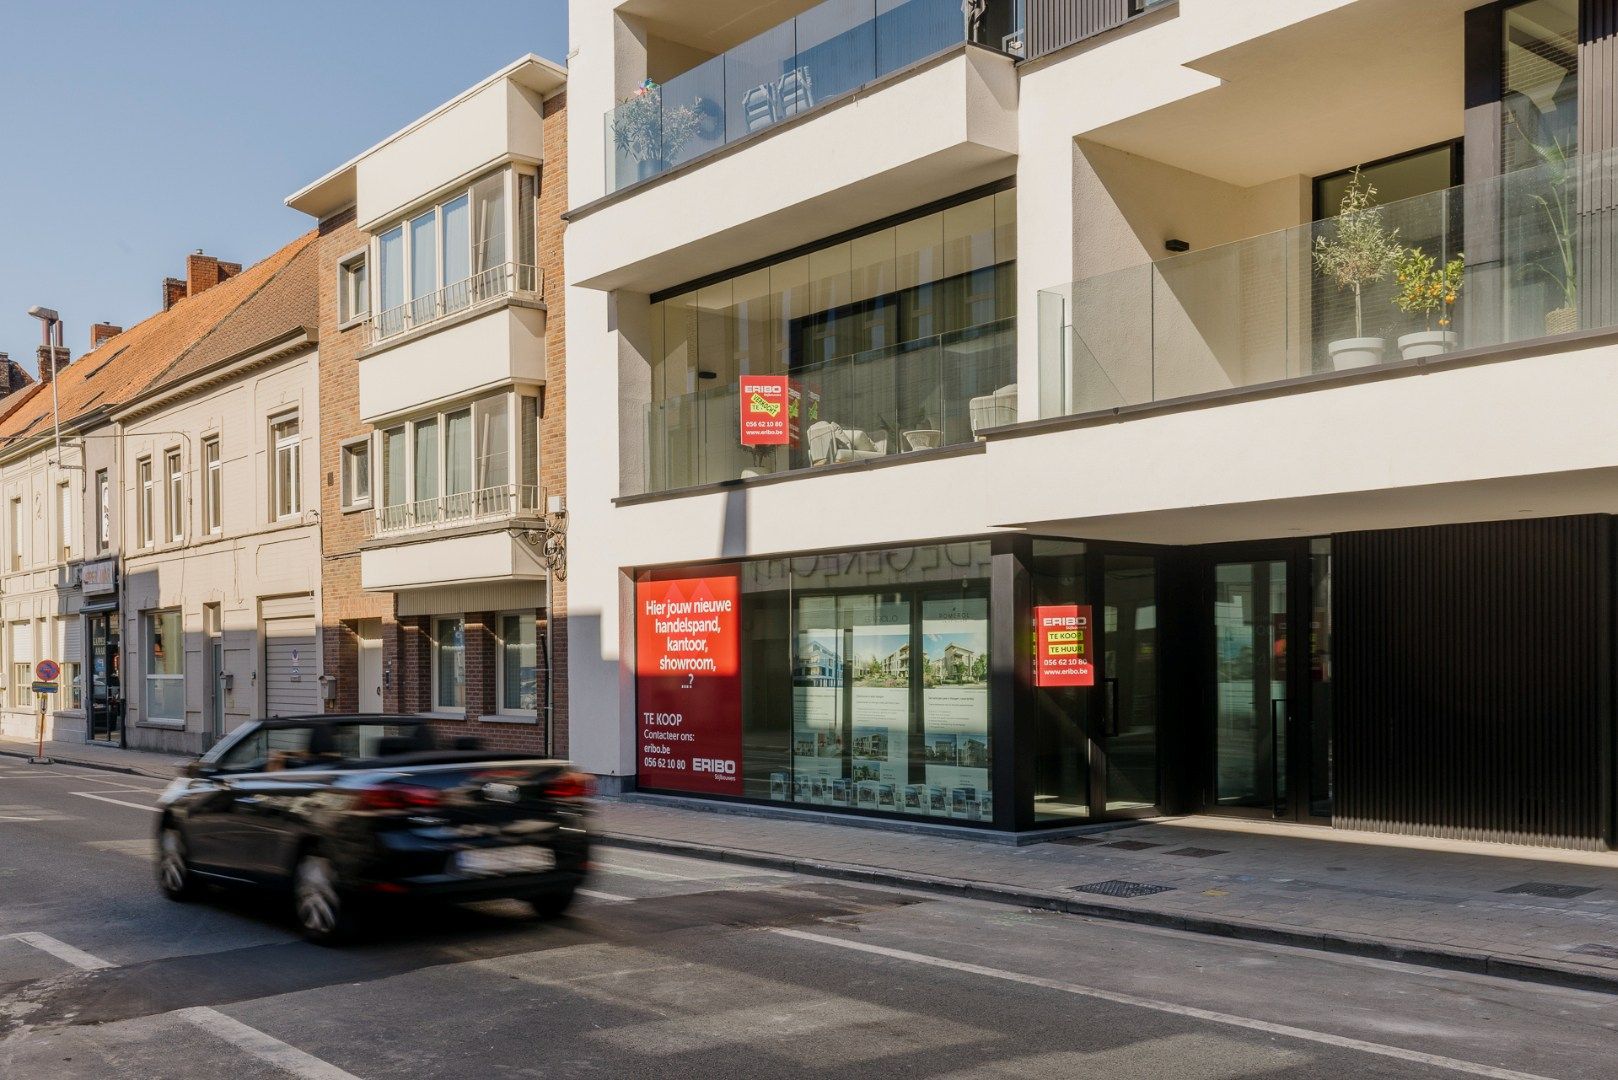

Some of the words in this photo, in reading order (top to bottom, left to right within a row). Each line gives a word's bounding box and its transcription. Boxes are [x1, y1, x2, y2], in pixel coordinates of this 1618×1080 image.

[744, 385, 782, 393] ERIBO
[645, 600, 666, 615] Hier
[666, 599, 692, 618] jouw
[694, 598, 732, 613] nieuwe
[655, 616, 721, 636] handelspand,
[1043, 616, 1087, 626] ERIBO
[666, 636, 708, 653] kantoor,
[660, 655, 716, 672] showroom,
[644, 712, 654, 724] TE
[656, 713, 682, 726] KOOP
[644, 729, 679, 740] Contacteer
[680, 732, 695, 742] ons:
[644, 744, 670, 754] eribo.be
[644, 757, 656, 767] 056
[658, 758, 666, 768] 62
[668, 759, 676, 768] 10
[676, 760, 686, 770] 80
[692, 758, 736, 774] ERIBO
